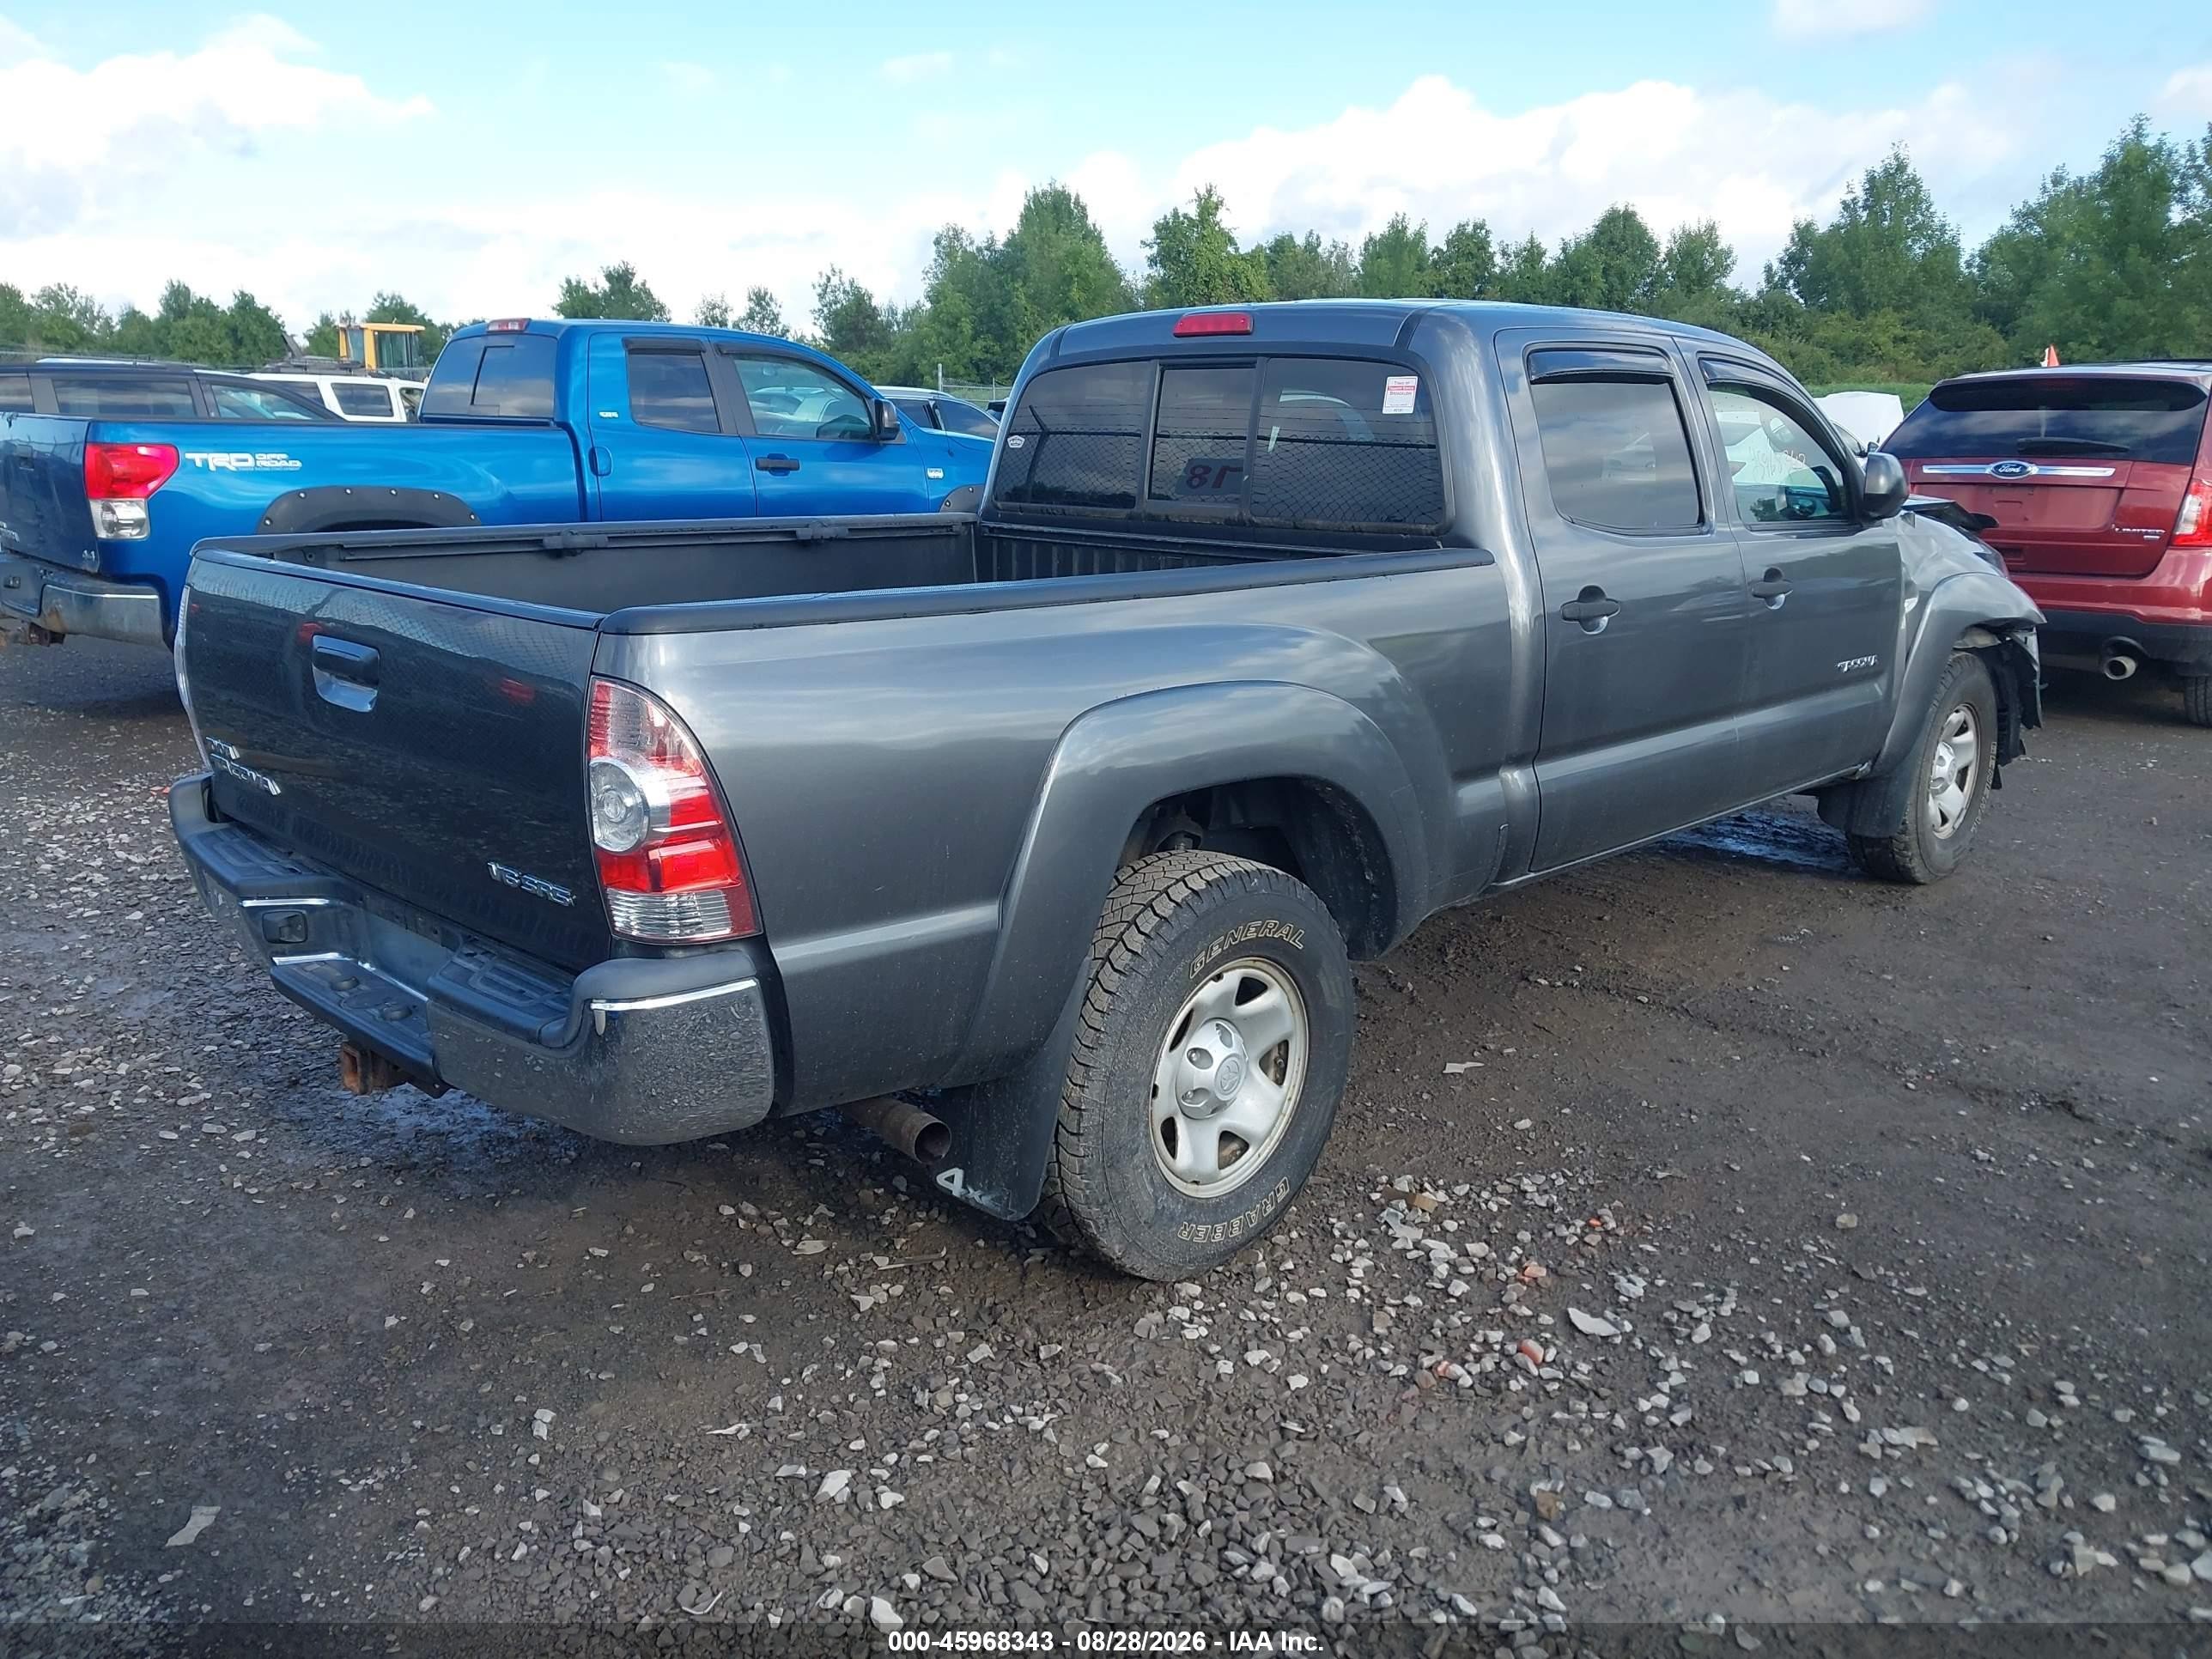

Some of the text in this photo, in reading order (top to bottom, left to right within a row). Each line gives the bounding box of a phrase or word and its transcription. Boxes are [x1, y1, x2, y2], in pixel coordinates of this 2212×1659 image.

[185, 452, 255, 471] TRD
[255, 459, 302, 467] ROAD
[1998, 464, 2022, 473] Ford
[1189, 920, 1304, 979] GENERAL
[1177, 1176, 1290, 1243] GRABBER
